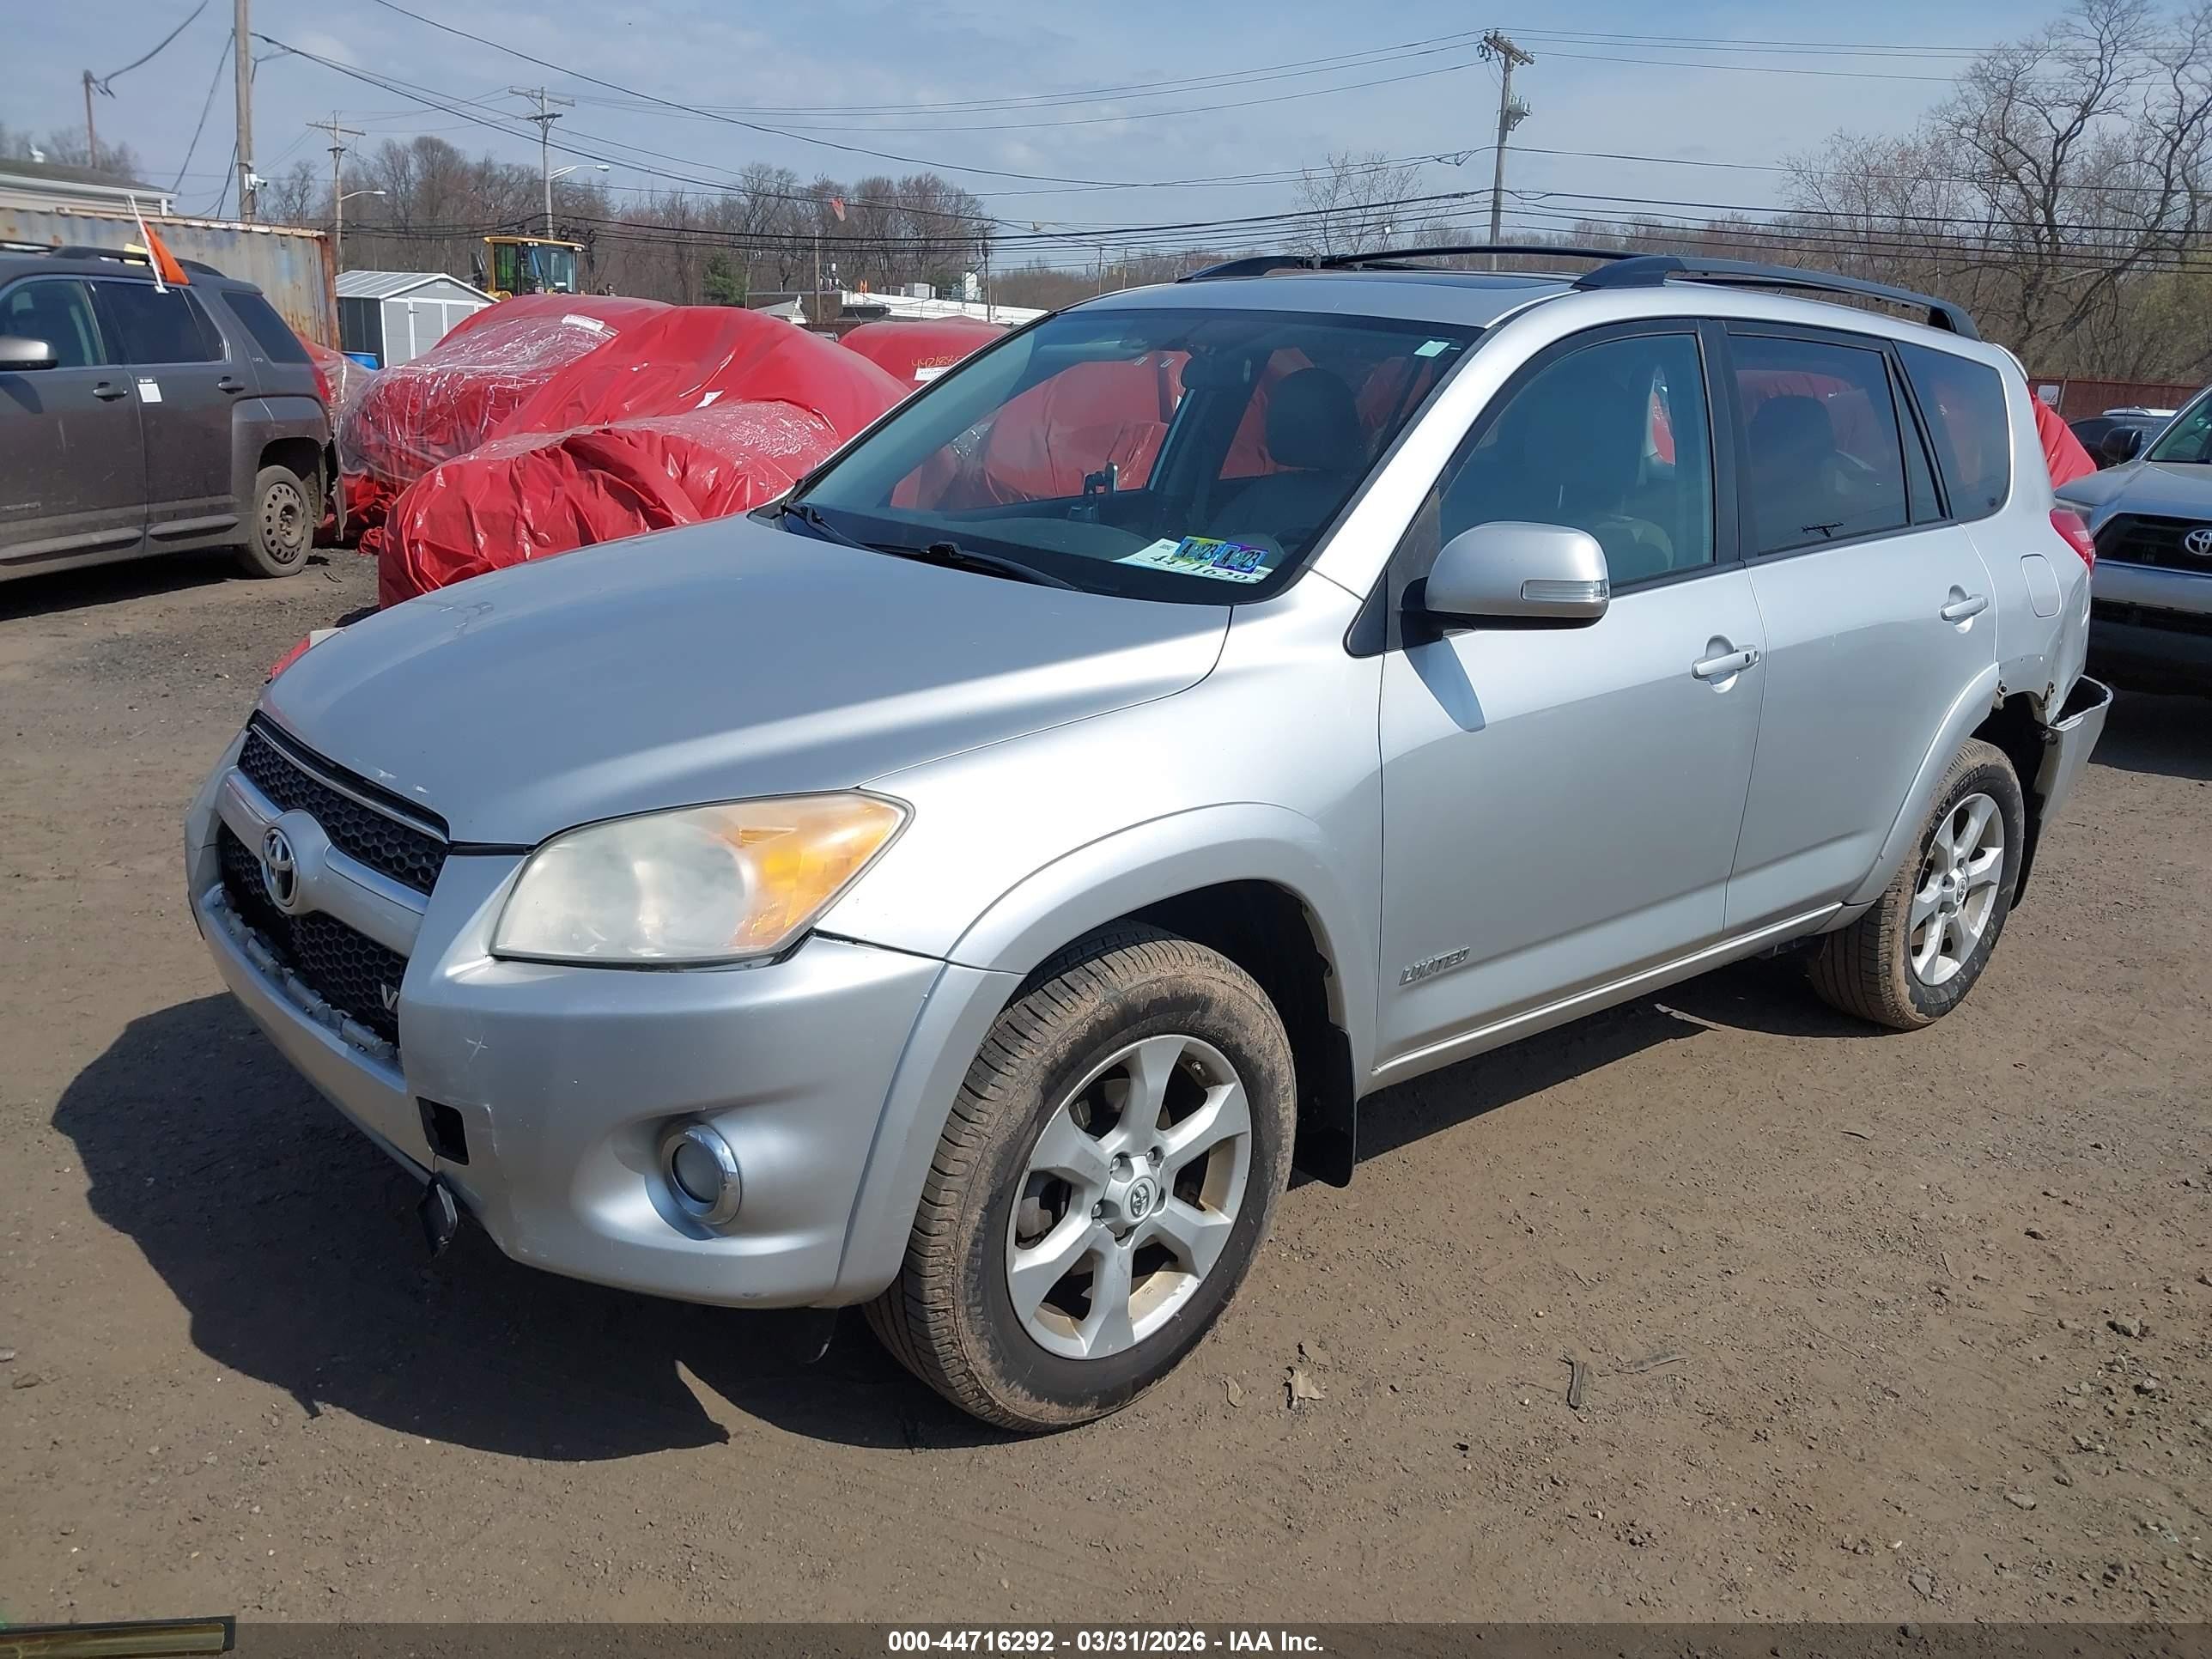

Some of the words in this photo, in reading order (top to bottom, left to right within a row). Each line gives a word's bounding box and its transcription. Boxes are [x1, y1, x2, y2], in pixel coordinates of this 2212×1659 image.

[1181, 543, 1194, 557] 4
[1221, 550, 1235, 565] 4
[1399, 946, 1470, 986] LIMITED
